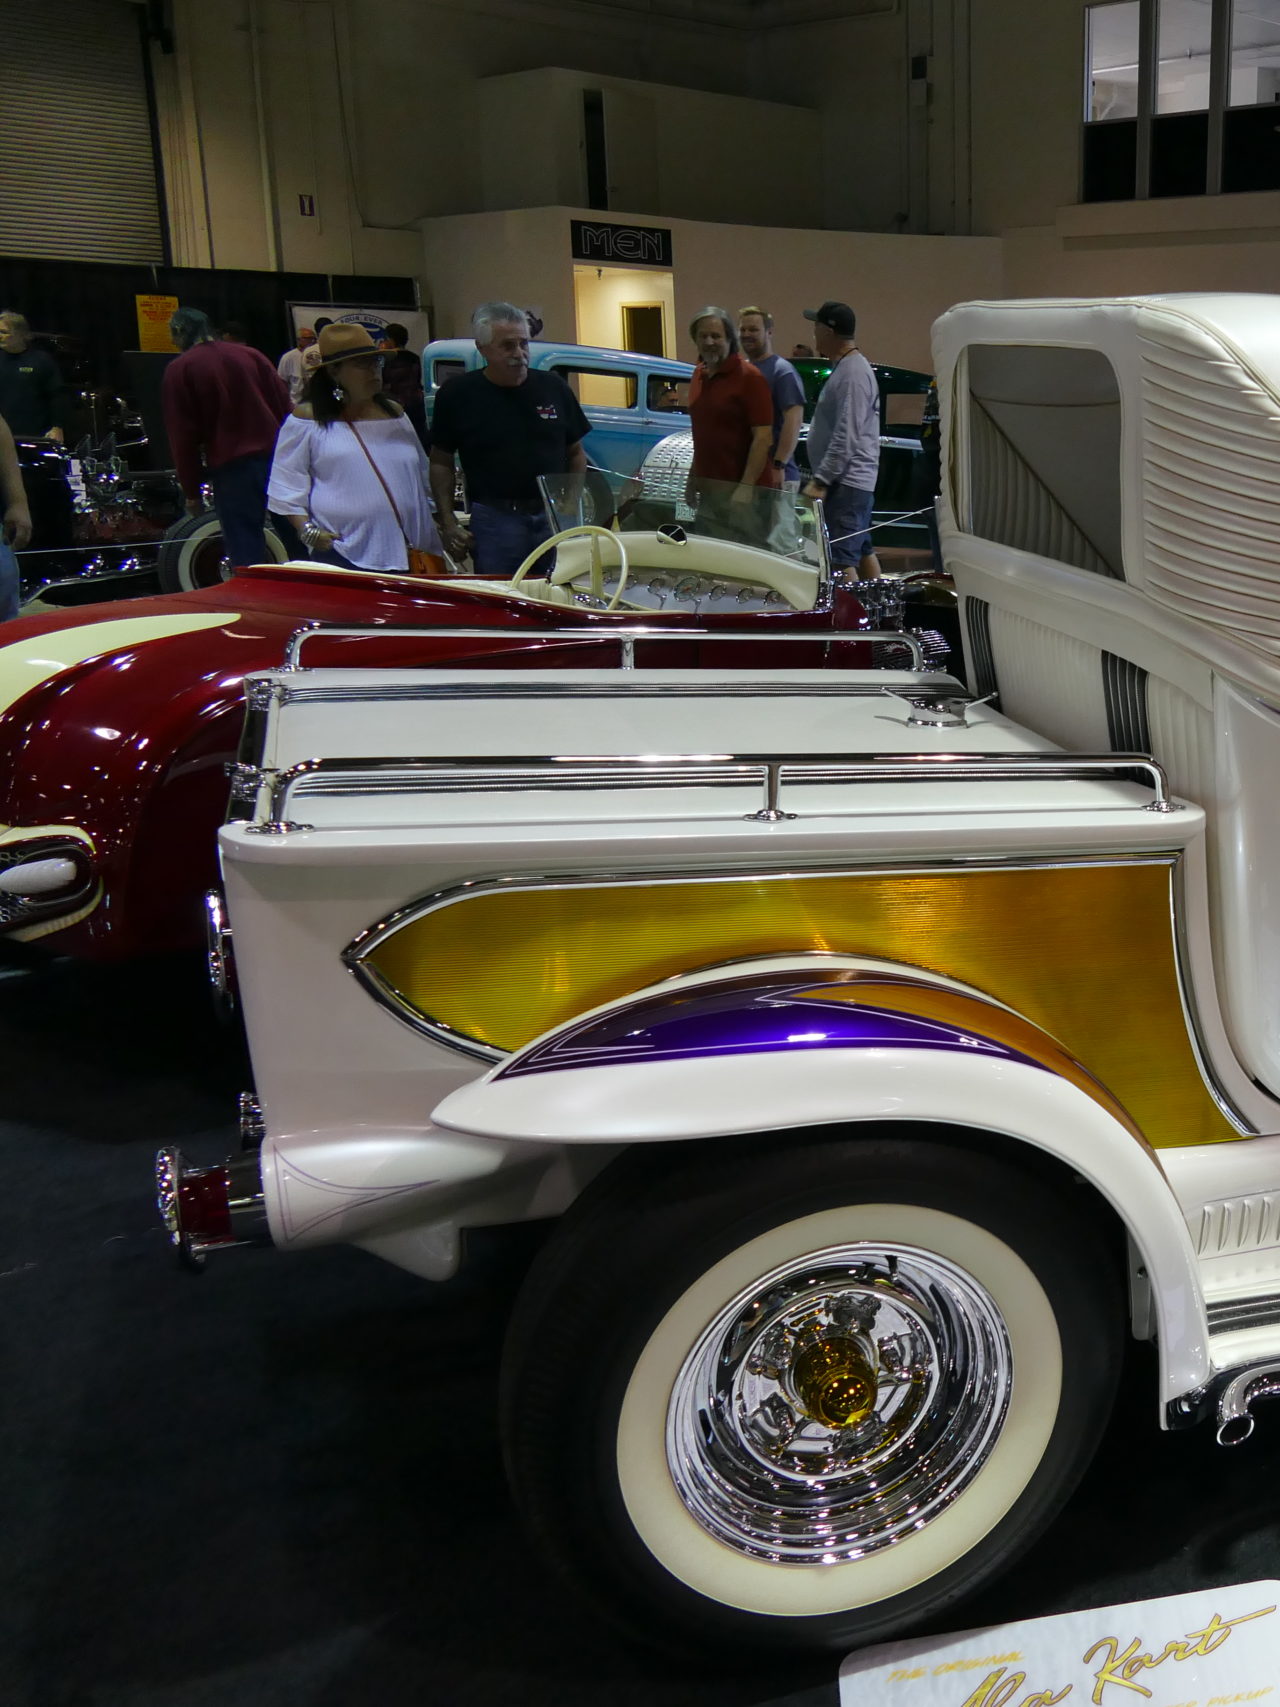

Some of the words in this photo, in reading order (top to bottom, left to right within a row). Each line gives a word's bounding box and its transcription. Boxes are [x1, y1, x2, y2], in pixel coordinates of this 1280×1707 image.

[581, 225, 663, 261] MEN
[885, 1666, 928, 1684] THE
[932, 1650, 1025, 1678] ORIGINAL
[1082, 1603, 1278, 1707] Kart
[1206, 1686, 1274, 1707] PICKUP
